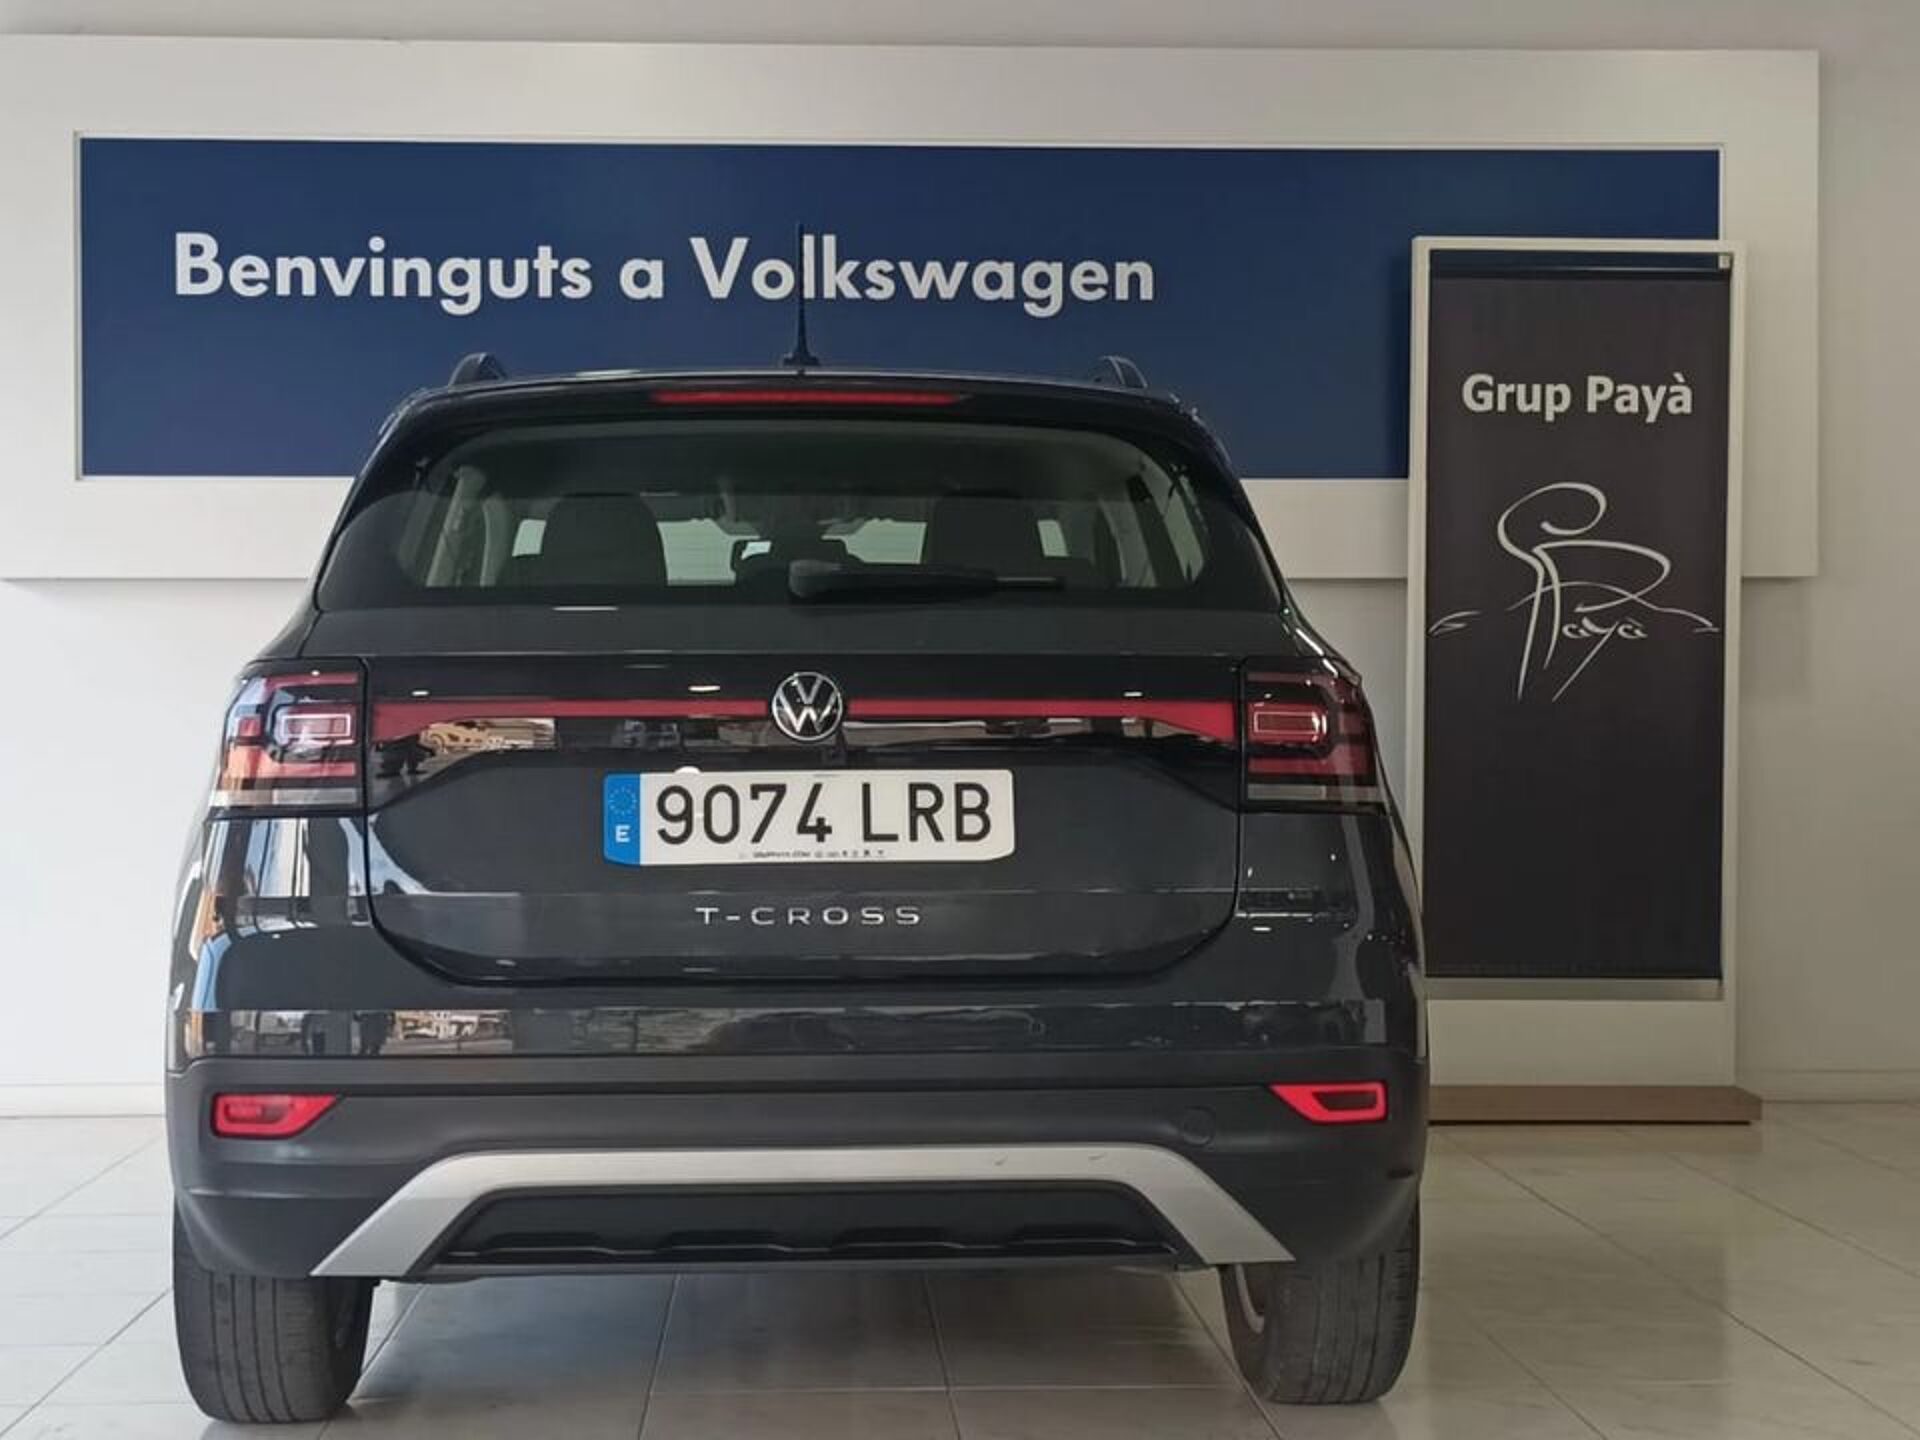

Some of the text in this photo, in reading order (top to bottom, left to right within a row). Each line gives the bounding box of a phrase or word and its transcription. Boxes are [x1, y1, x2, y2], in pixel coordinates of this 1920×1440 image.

[175, 232, 1156, 318] Benvinguts a Volkswagen
[1462, 372, 1693, 424] Grup Payà
[616, 826, 631, 843] E
[656, 782, 992, 846] 9074 LRB
[694, 907, 922, 926] T-CROSS
